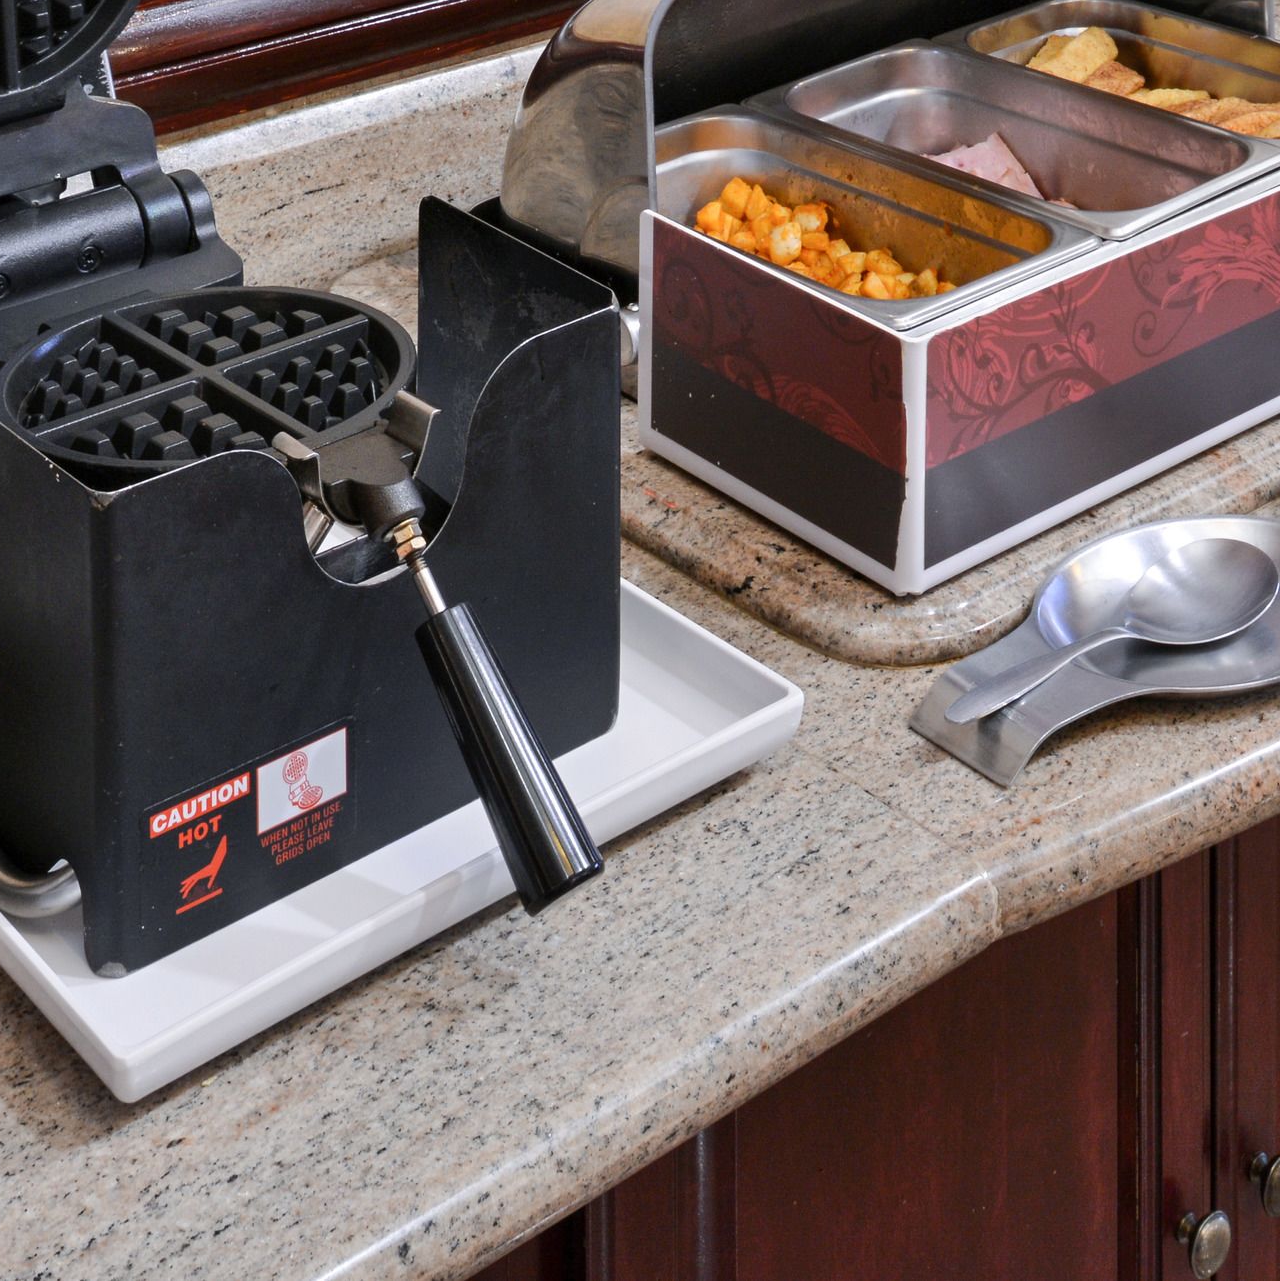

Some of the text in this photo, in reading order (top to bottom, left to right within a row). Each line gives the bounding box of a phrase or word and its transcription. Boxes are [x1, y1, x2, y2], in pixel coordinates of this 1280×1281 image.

[152, 775, 249, 834] CAUTION
[177, 814, 222, 849] HOT
[261, 826, 289, 848] WHEN
[290, 816, 309, 833] NOT
[311, 810, 321, 824] IN
[271, 816, 334, 856] PLEASE LEAVE
[275, 830, 331, 866] GRIDS OPEN
